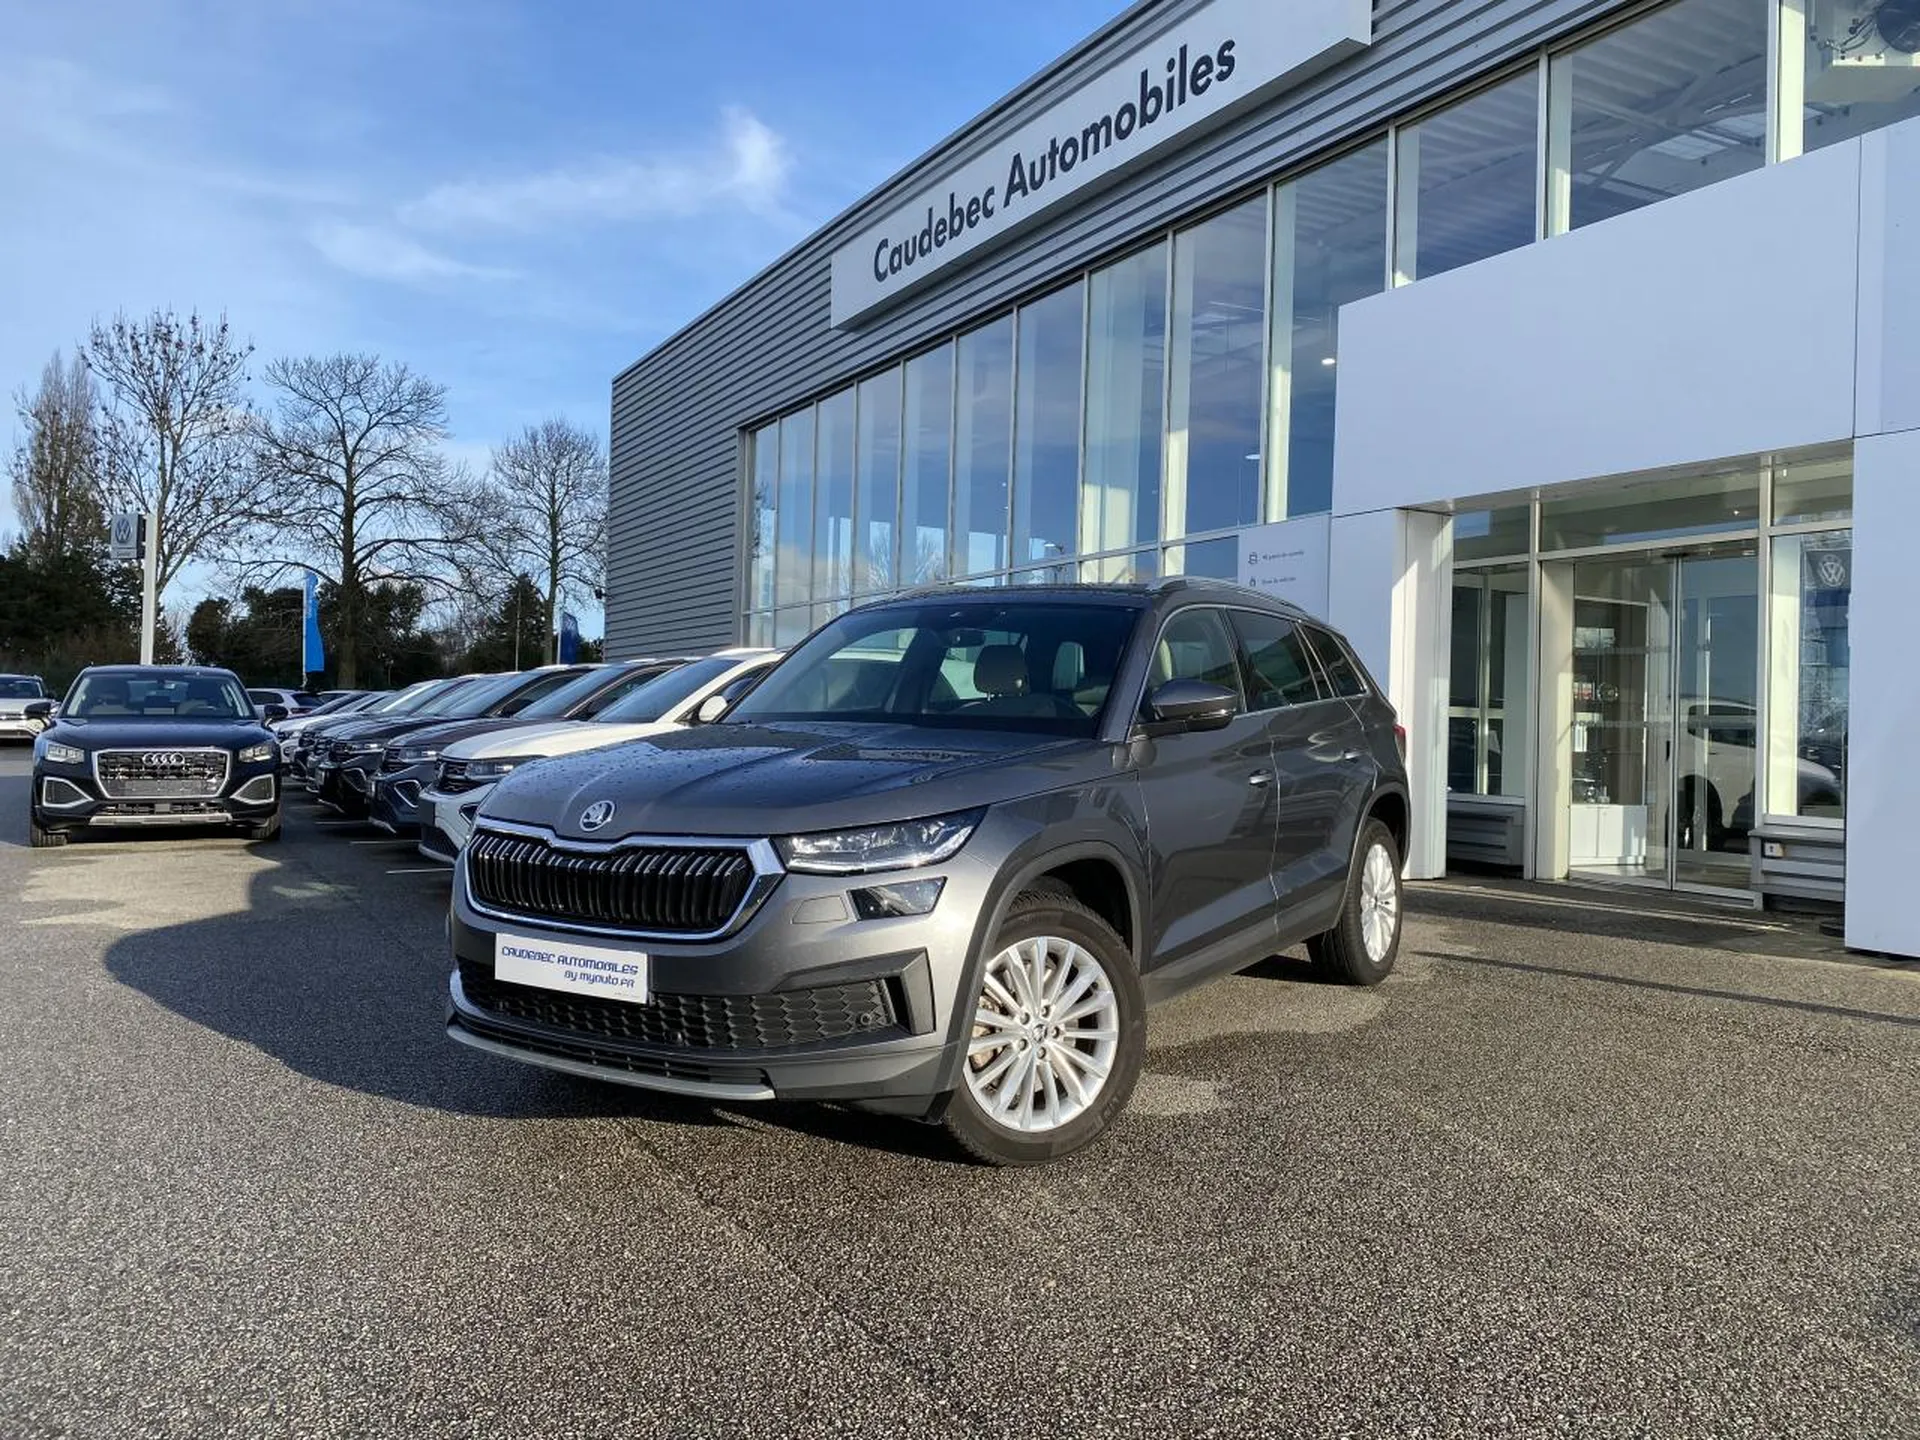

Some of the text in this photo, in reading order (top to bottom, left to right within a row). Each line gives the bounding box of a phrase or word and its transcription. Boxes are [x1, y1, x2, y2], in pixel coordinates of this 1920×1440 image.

[874, 38, 1236, 283] Caudebec Automobiles
[501, 945, 639, 975] CAUDEBEC AUTOMOBILES
